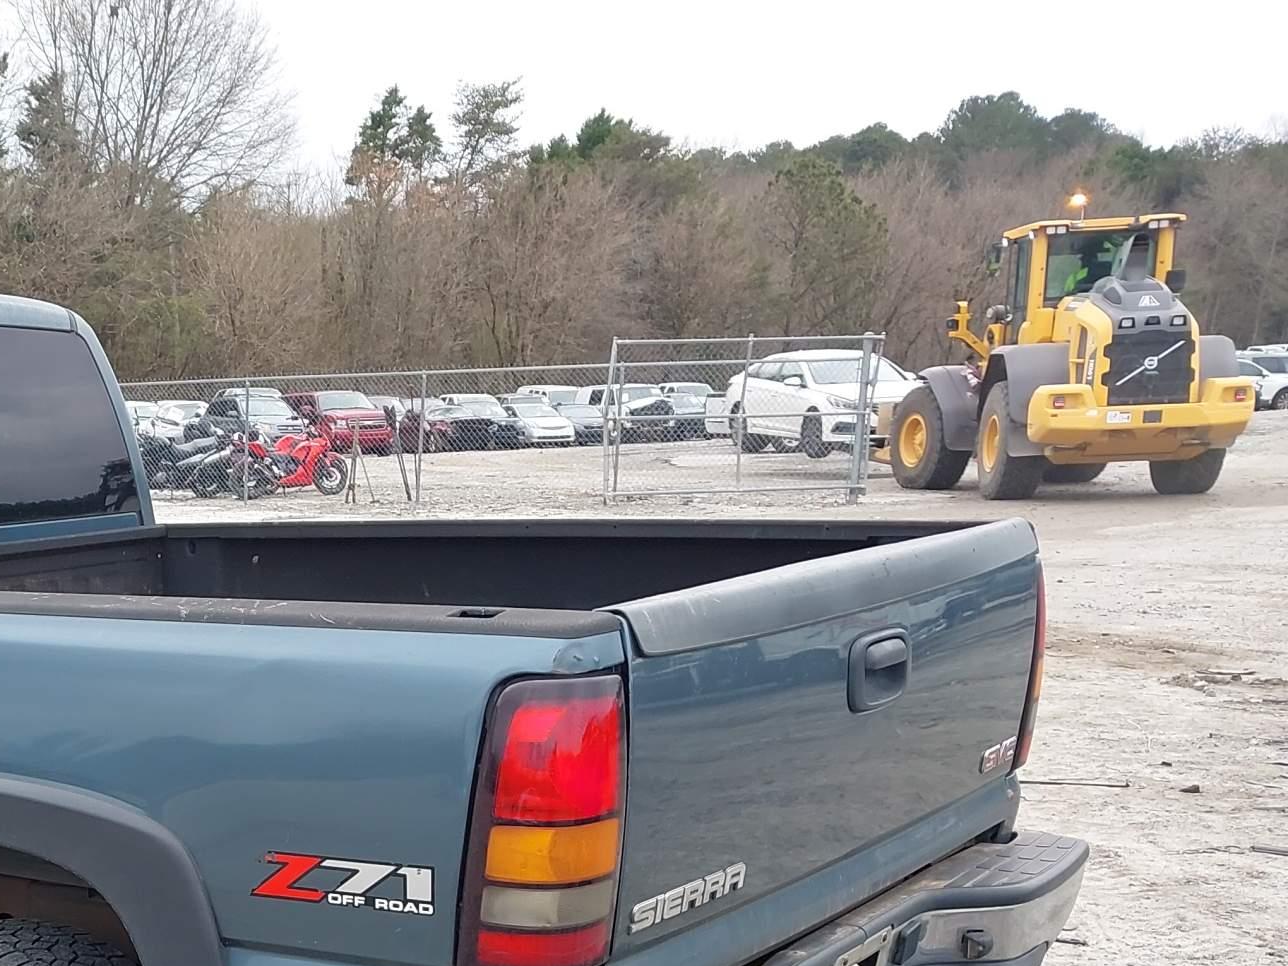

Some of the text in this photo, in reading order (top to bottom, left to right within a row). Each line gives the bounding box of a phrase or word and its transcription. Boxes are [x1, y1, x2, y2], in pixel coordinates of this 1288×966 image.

[252, 851, 434, 903] Z71
[629, 861, 746, 934] SIERRA
[327, 893, 434, 915] OFF ROAD
